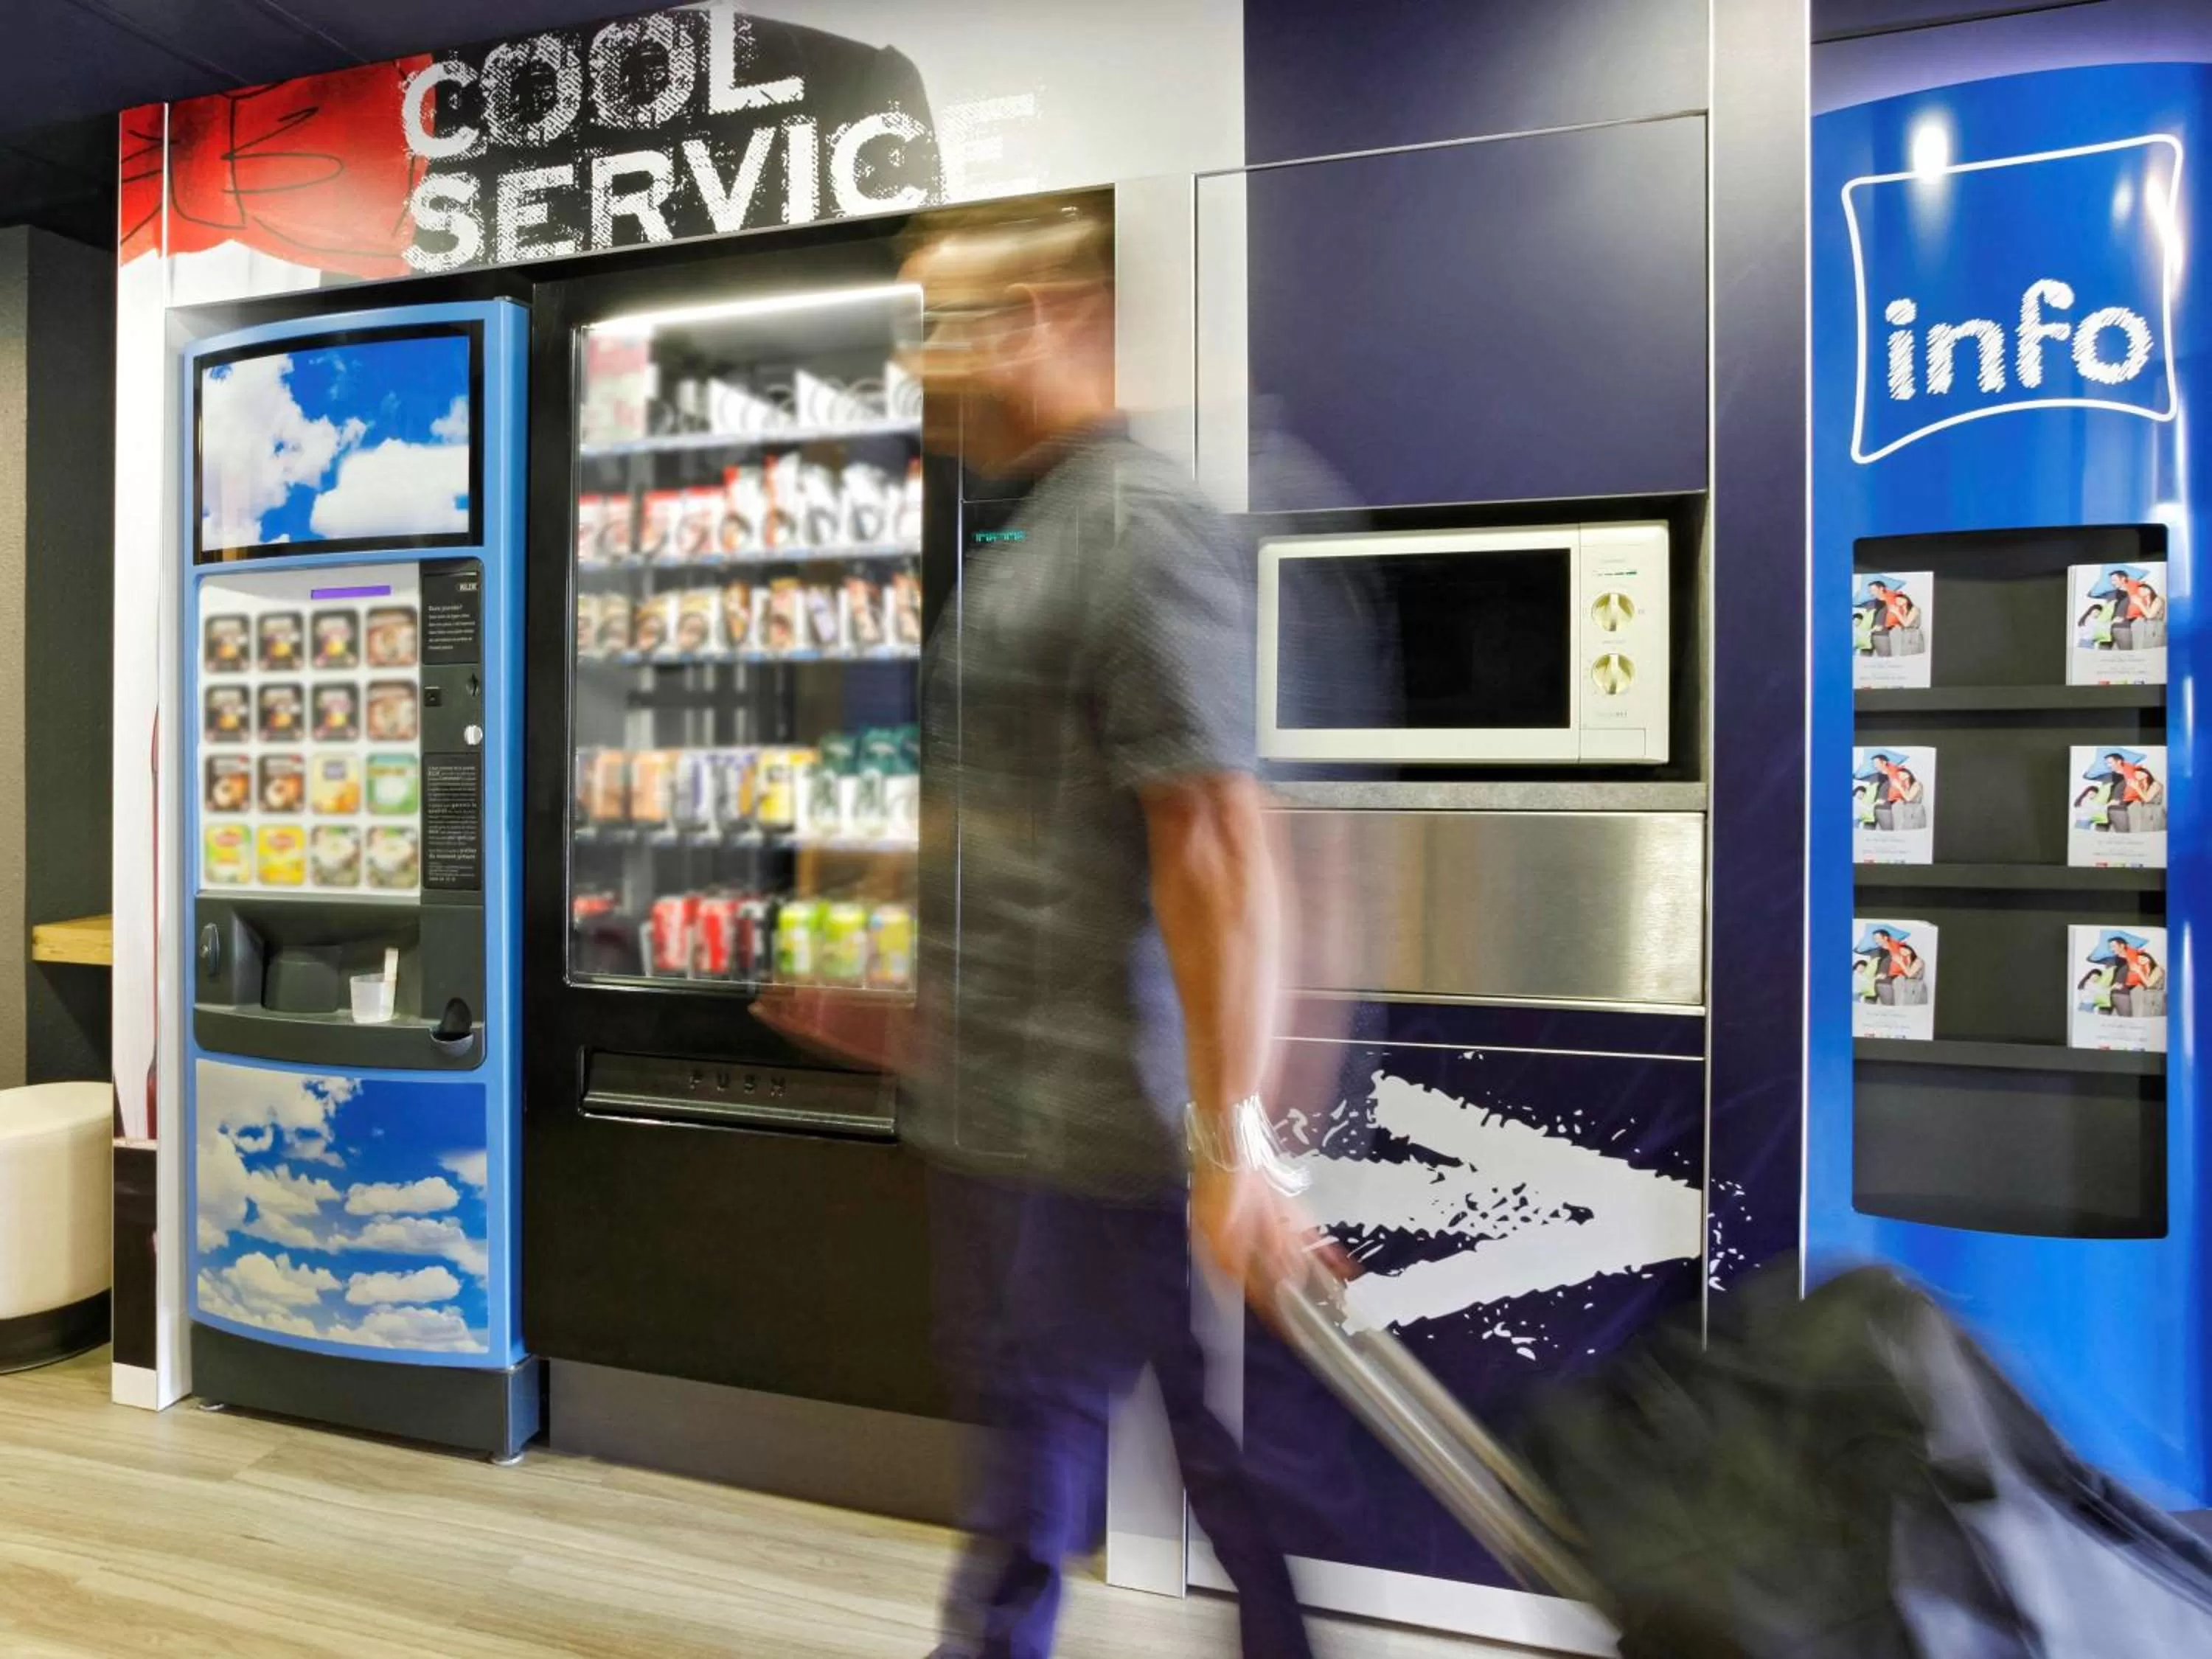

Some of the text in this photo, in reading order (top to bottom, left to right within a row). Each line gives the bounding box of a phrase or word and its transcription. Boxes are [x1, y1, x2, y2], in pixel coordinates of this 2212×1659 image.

[400, 0, 805, 161] COOL
[400, 90, 1041, 273] SERVICE
[1885, 278, 2154, 400] info
